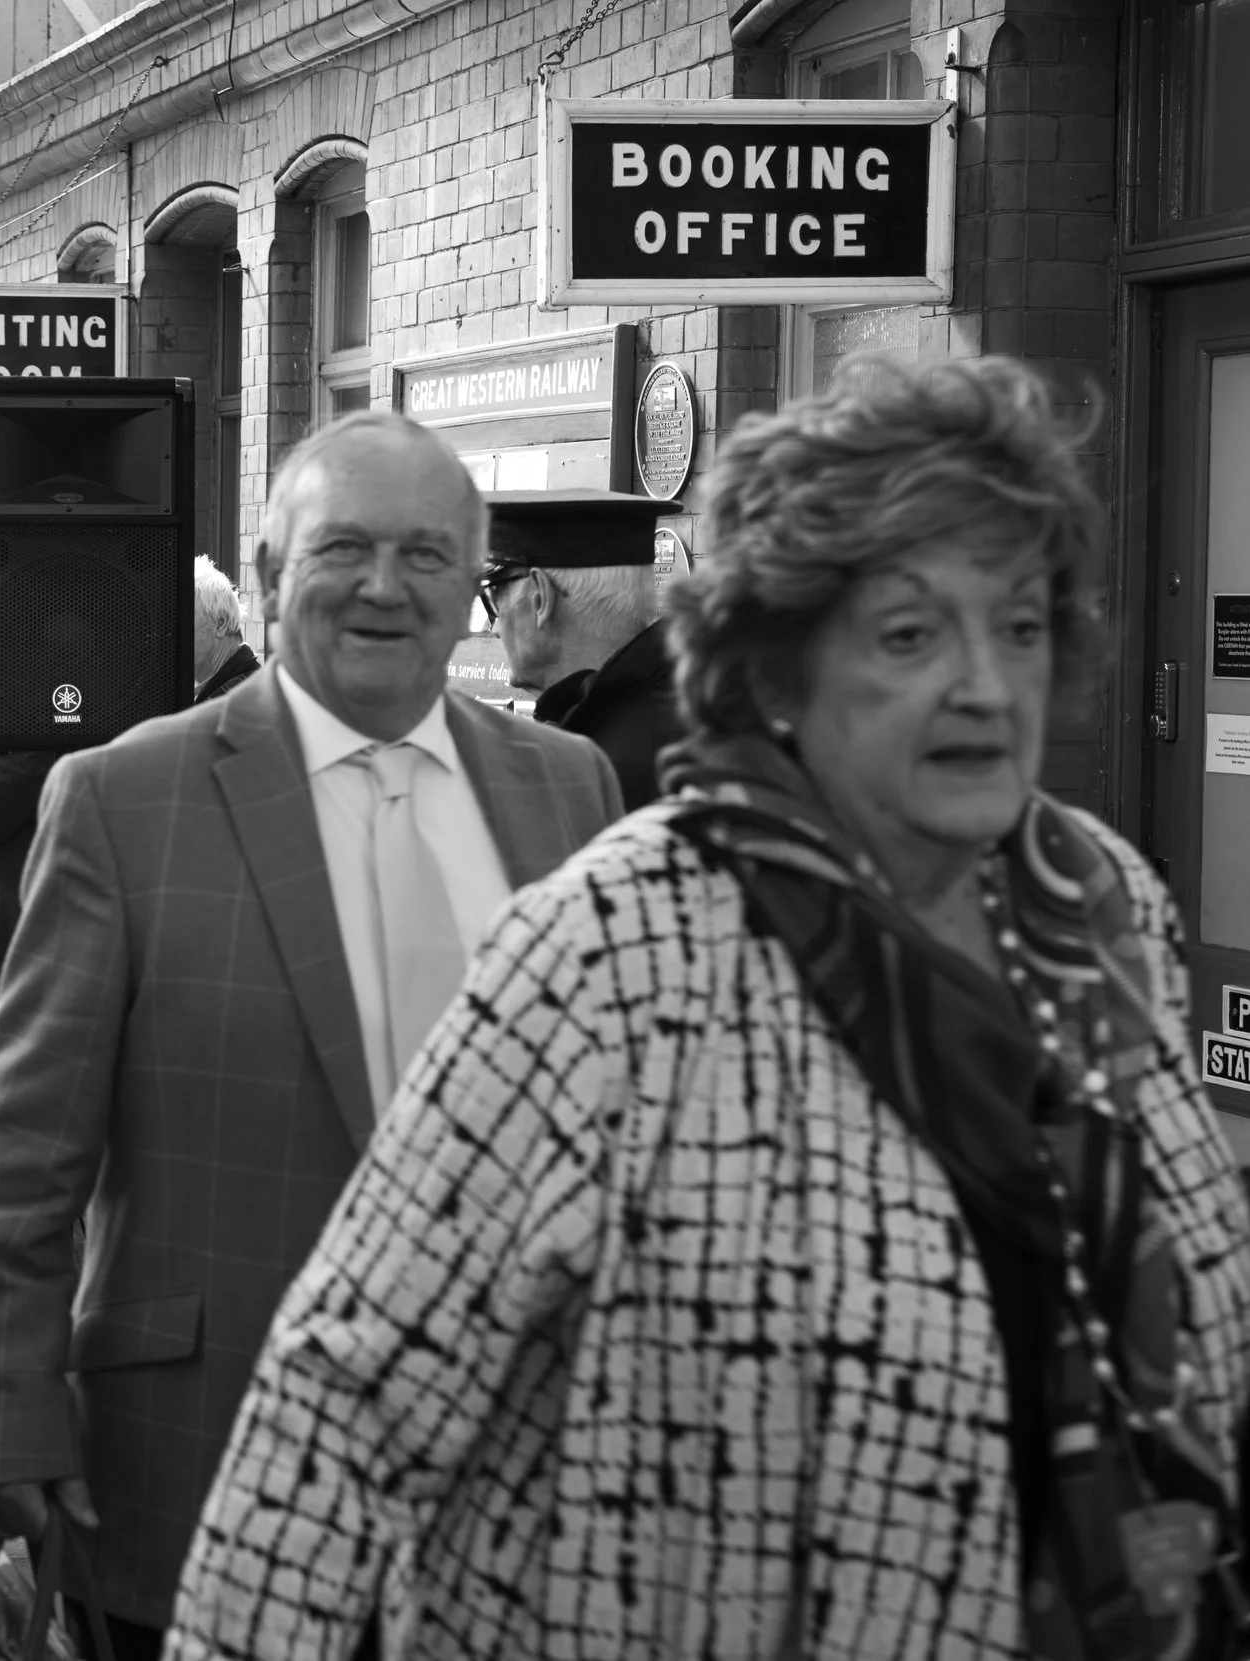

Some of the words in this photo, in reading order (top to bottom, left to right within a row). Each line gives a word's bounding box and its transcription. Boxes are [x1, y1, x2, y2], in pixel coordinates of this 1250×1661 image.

[612, 142, 890, 192] BOOKING
[634, 210, 867, 257] OFFICE
[411, 376, 454, 412] GREAT
[457, 367, 526, 406] WESTERN
[529, 356, 602, 399] RAILWAY
[448, 661, 456, 677] in
[458, 663, 486, 680] service
[53, 715, 81, 723] YAMAHA
[1239, 997, 1250, 1028] P
